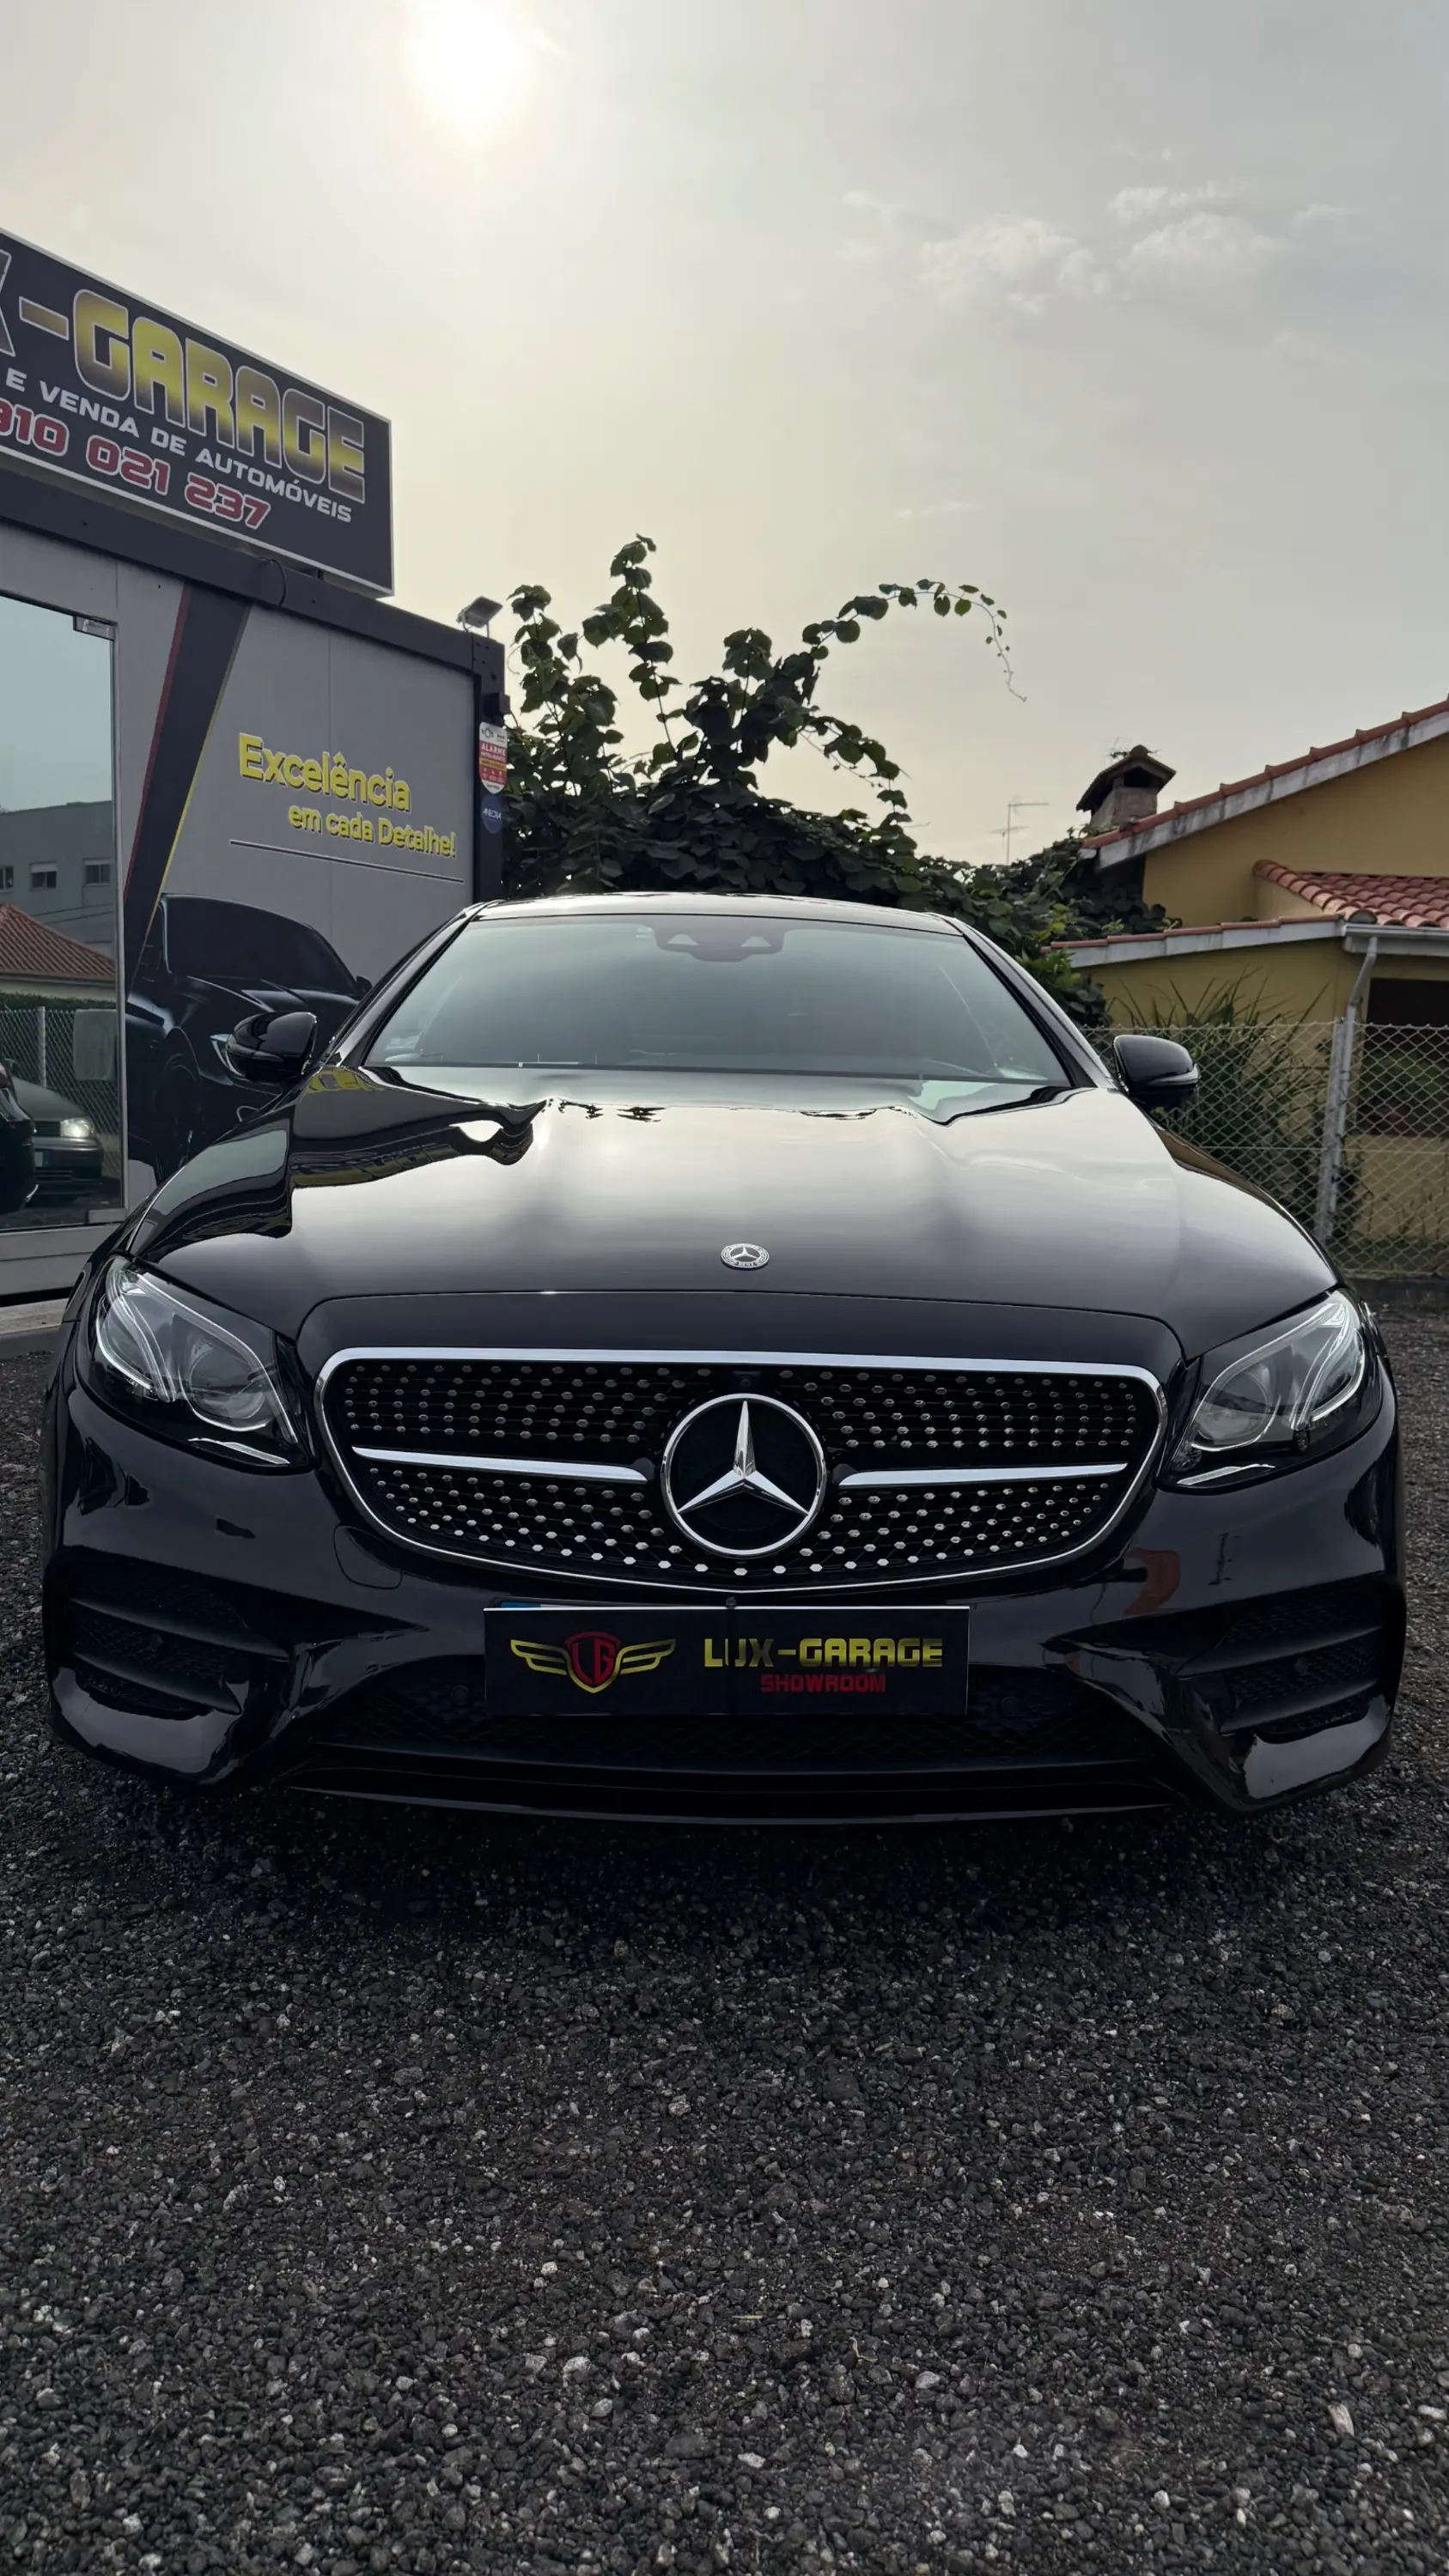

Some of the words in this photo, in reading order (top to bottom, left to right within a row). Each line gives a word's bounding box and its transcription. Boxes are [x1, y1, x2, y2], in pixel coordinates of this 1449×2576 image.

[6, 368, 27, 392] E
[40, 380, 140, 439] VENDA
[150, 429, 187, 457] DE
[195, 447, 353, 523] AUTOMÓVEIS
[86, 434, 171, 495] 021
[184, 471, 271, 530] 237
[240, 732, 411, 811] Excelência
[481, 743, 506, 756] ALARME
[289, 805, 322, 833] em
[326, 811, 374, 844] cada
[378, 817, 457, 858] Detalhe!
[703, 1637, 944, 1668] LUX-GARAGE
[760, 1673, 887, 1694] SHOWROOM
